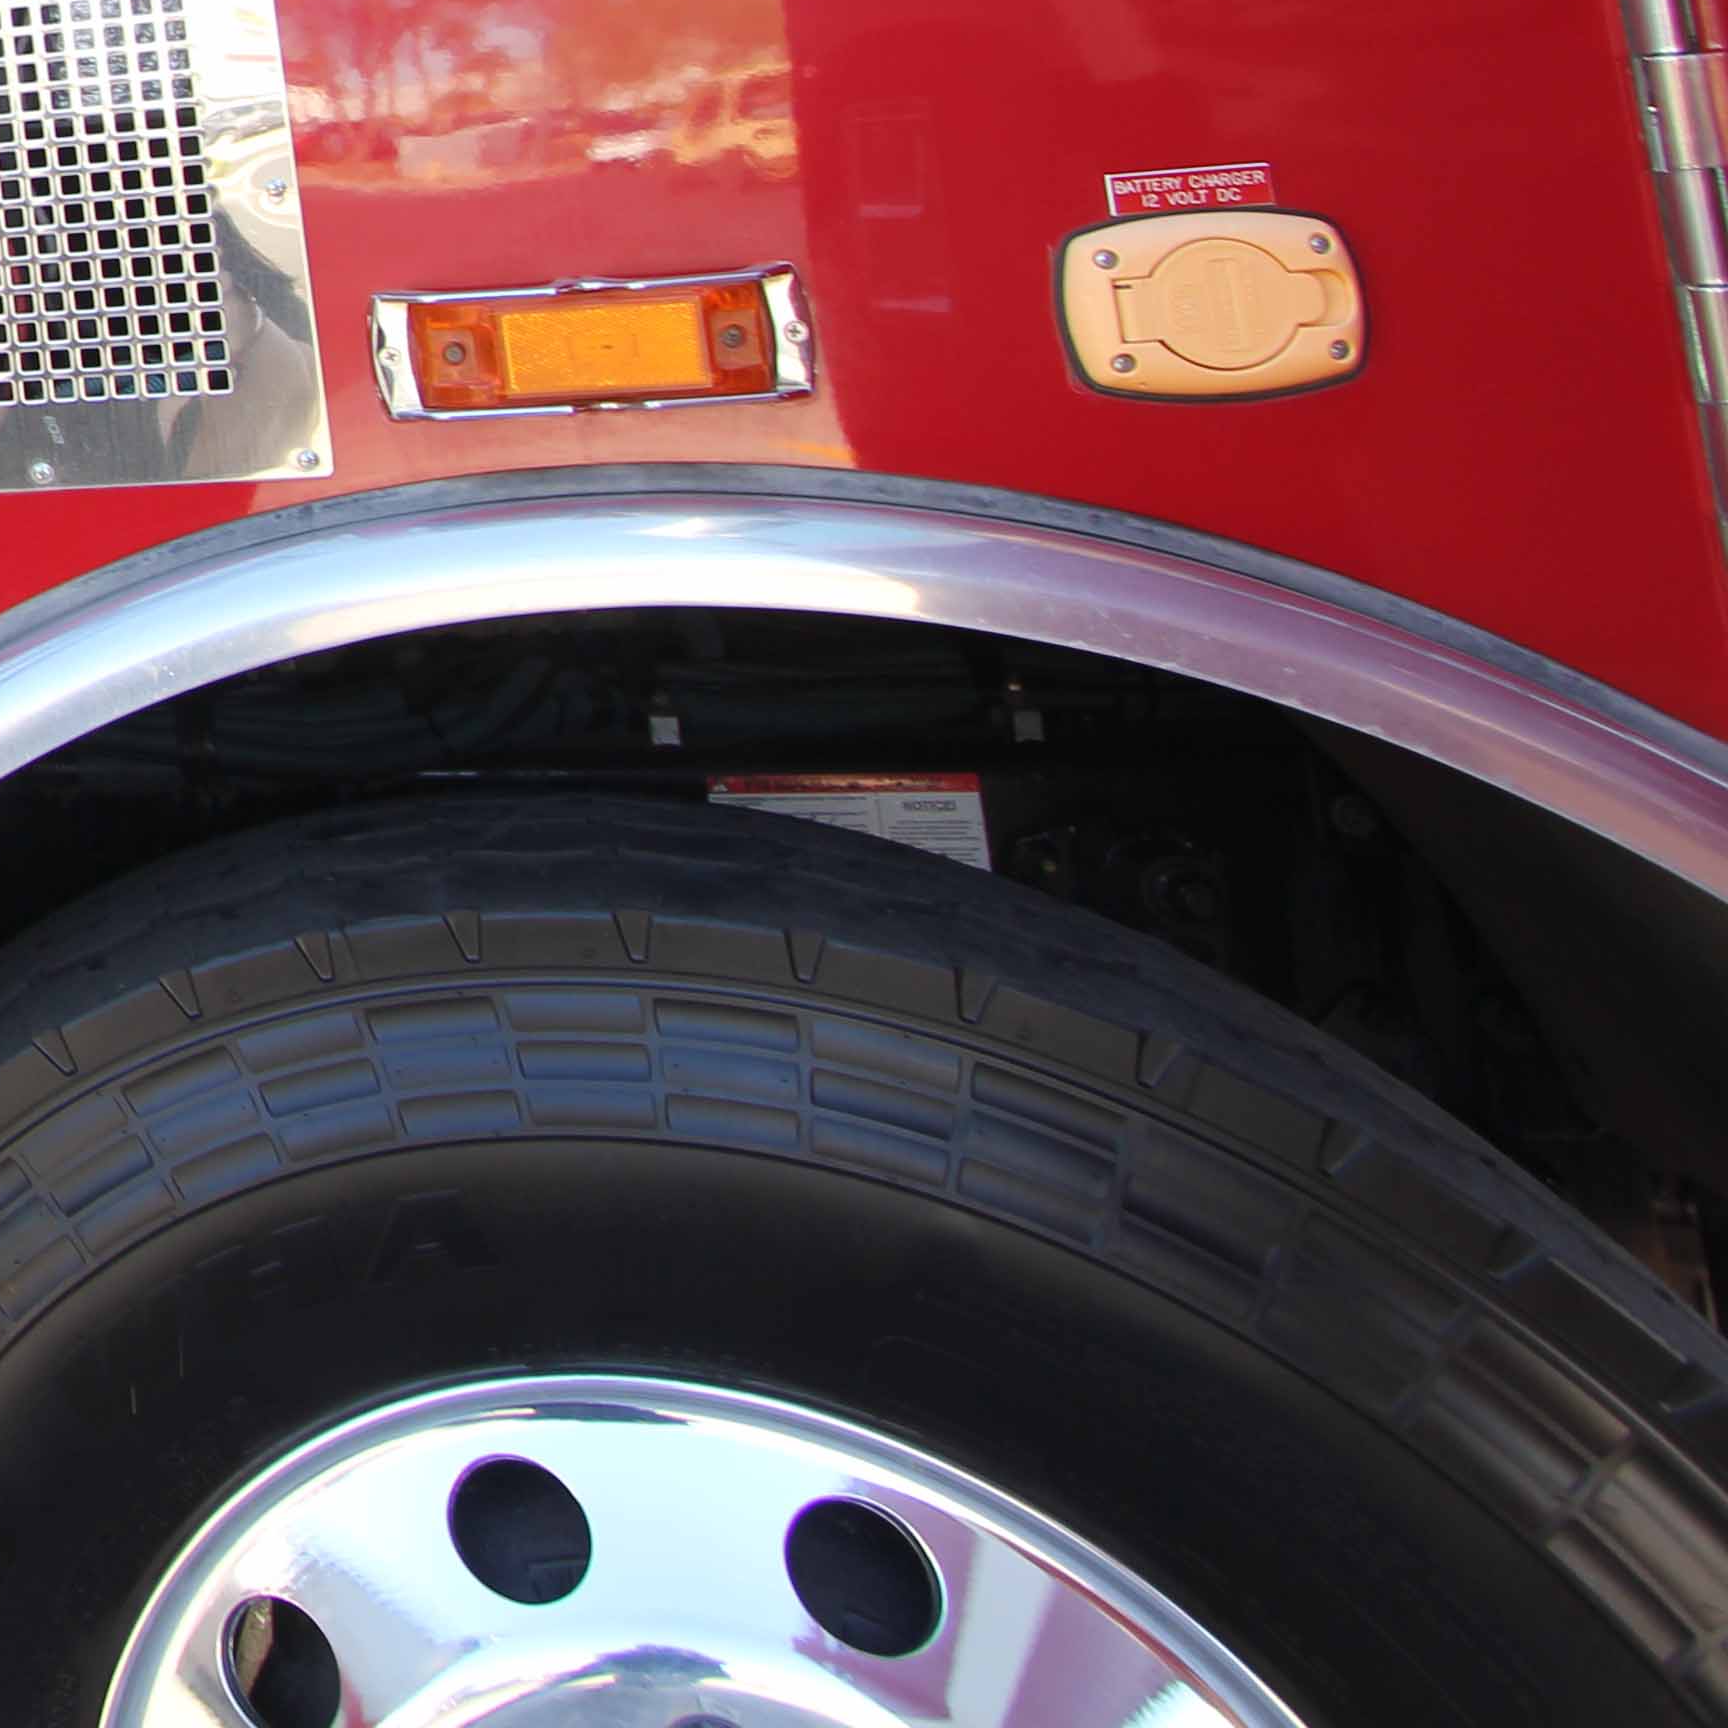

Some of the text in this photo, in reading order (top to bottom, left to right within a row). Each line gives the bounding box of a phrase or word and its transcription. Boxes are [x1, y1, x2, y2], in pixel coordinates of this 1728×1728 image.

[1113, 170, 1266, 195] BATTERY CHARGER
[1141, 187, 1243, 209] 12 VOLT DC
